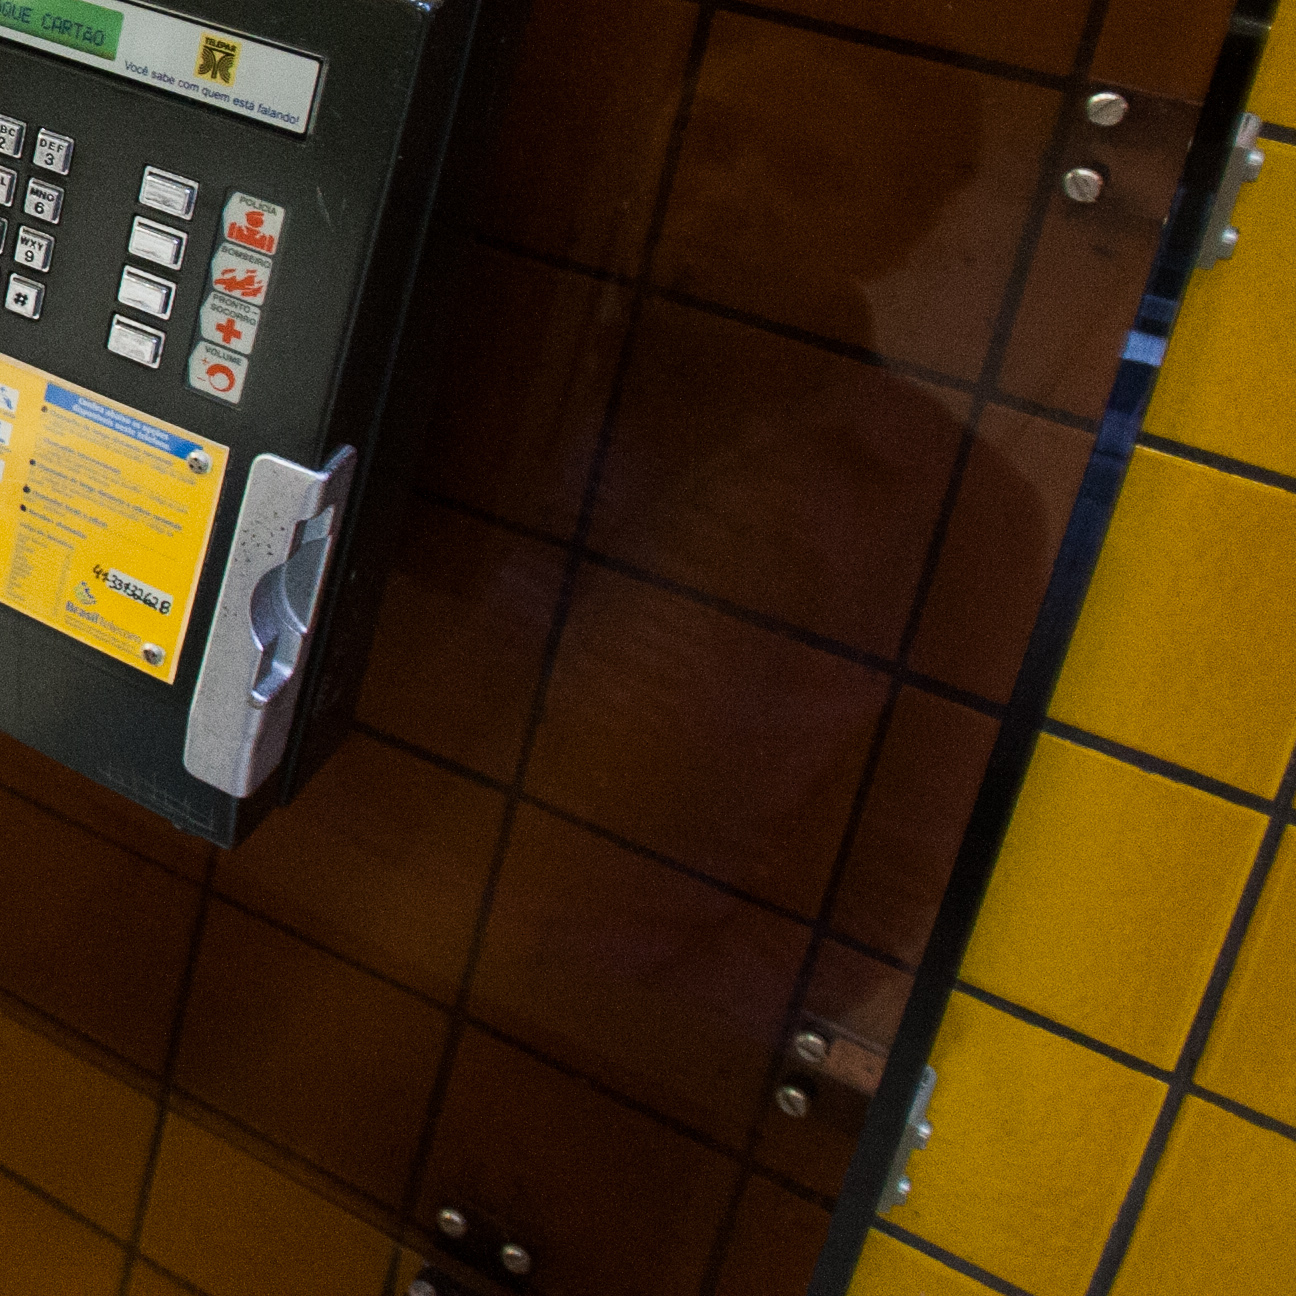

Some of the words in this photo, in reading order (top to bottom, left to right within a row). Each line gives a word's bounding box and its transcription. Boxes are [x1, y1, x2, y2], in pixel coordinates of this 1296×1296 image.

[204, 37, 237, 53] TELEPAR
[124, 60, 149, 76] Você
[151, 70, 176, 85] sabe
[178, 80, 200, 92] com
[201, 87, 230, 103] quem
[233, 96, 255, 111] está
[257, 103, 300, 125] falando!
[39, 138, 64, 153] DEF
[44, 153, 55, 166] 3
[30, 187, 55, 202] MNO
[34, 201, 45, 214] 6
[20, 236, 44, 251] WXY
[24, 250, 35, 263] 9
[210, 303, 257, 326] SOCORRO
[205, 345, 243, 366] VOLUME
